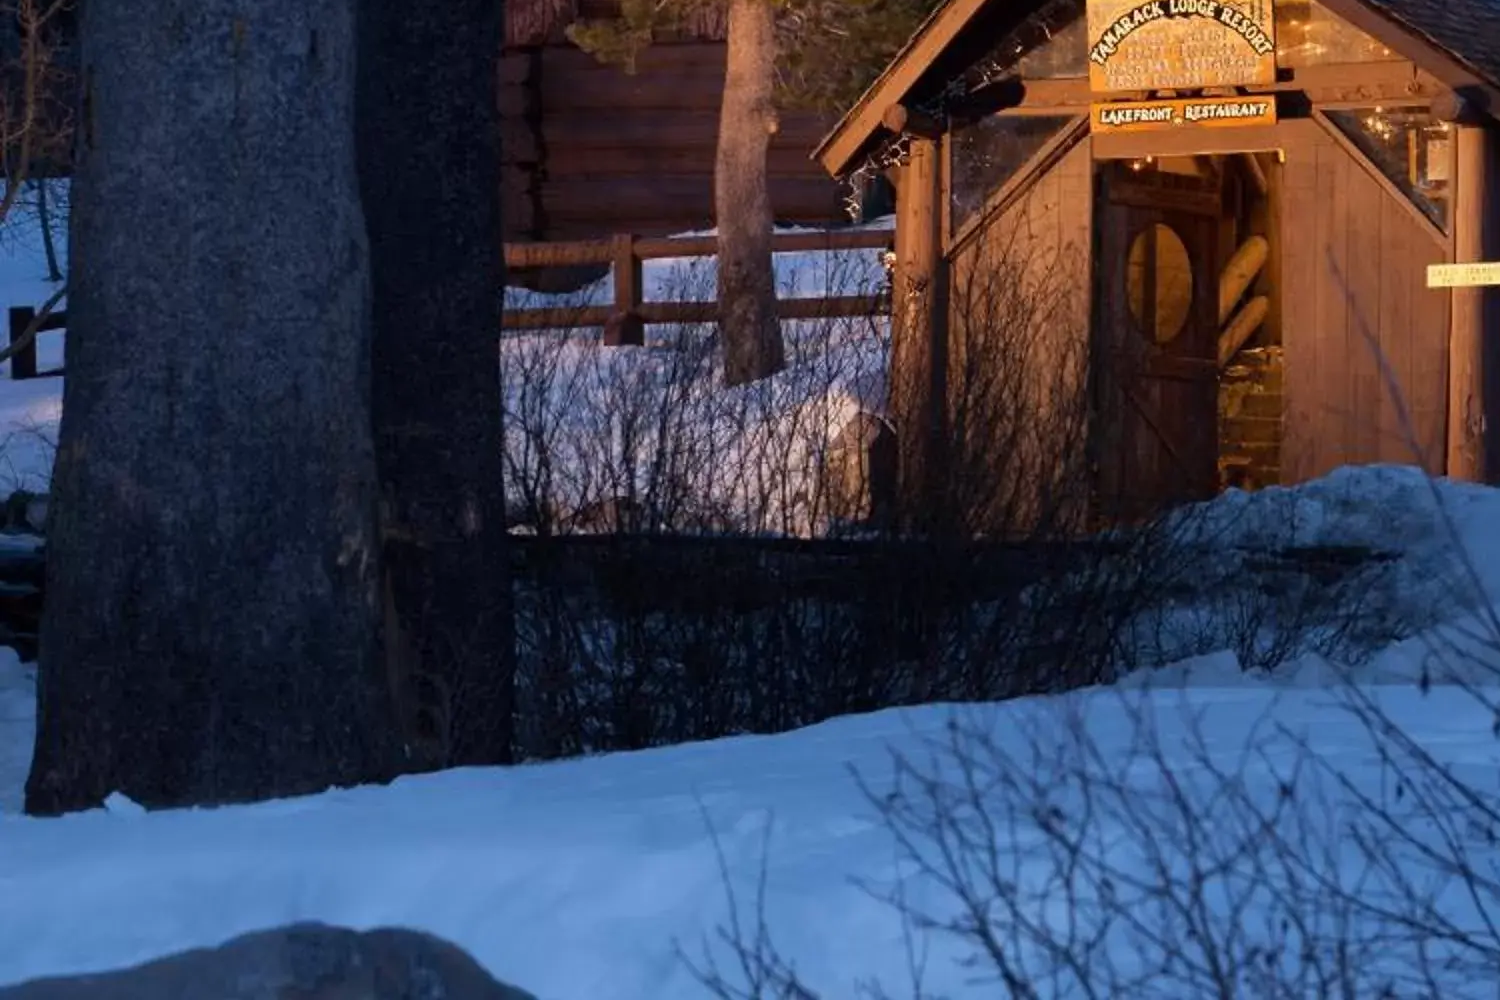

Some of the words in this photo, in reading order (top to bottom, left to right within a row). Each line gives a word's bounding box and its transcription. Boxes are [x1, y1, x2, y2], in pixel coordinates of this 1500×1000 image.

[1090, 1, 1165, 64] TAMARACK
[1221, 6, 1274, 55] RESORT
[1101, 107, 1173, 124] LAKEFRONT
[1184, 103, 1268, 120] RESTAURANT
